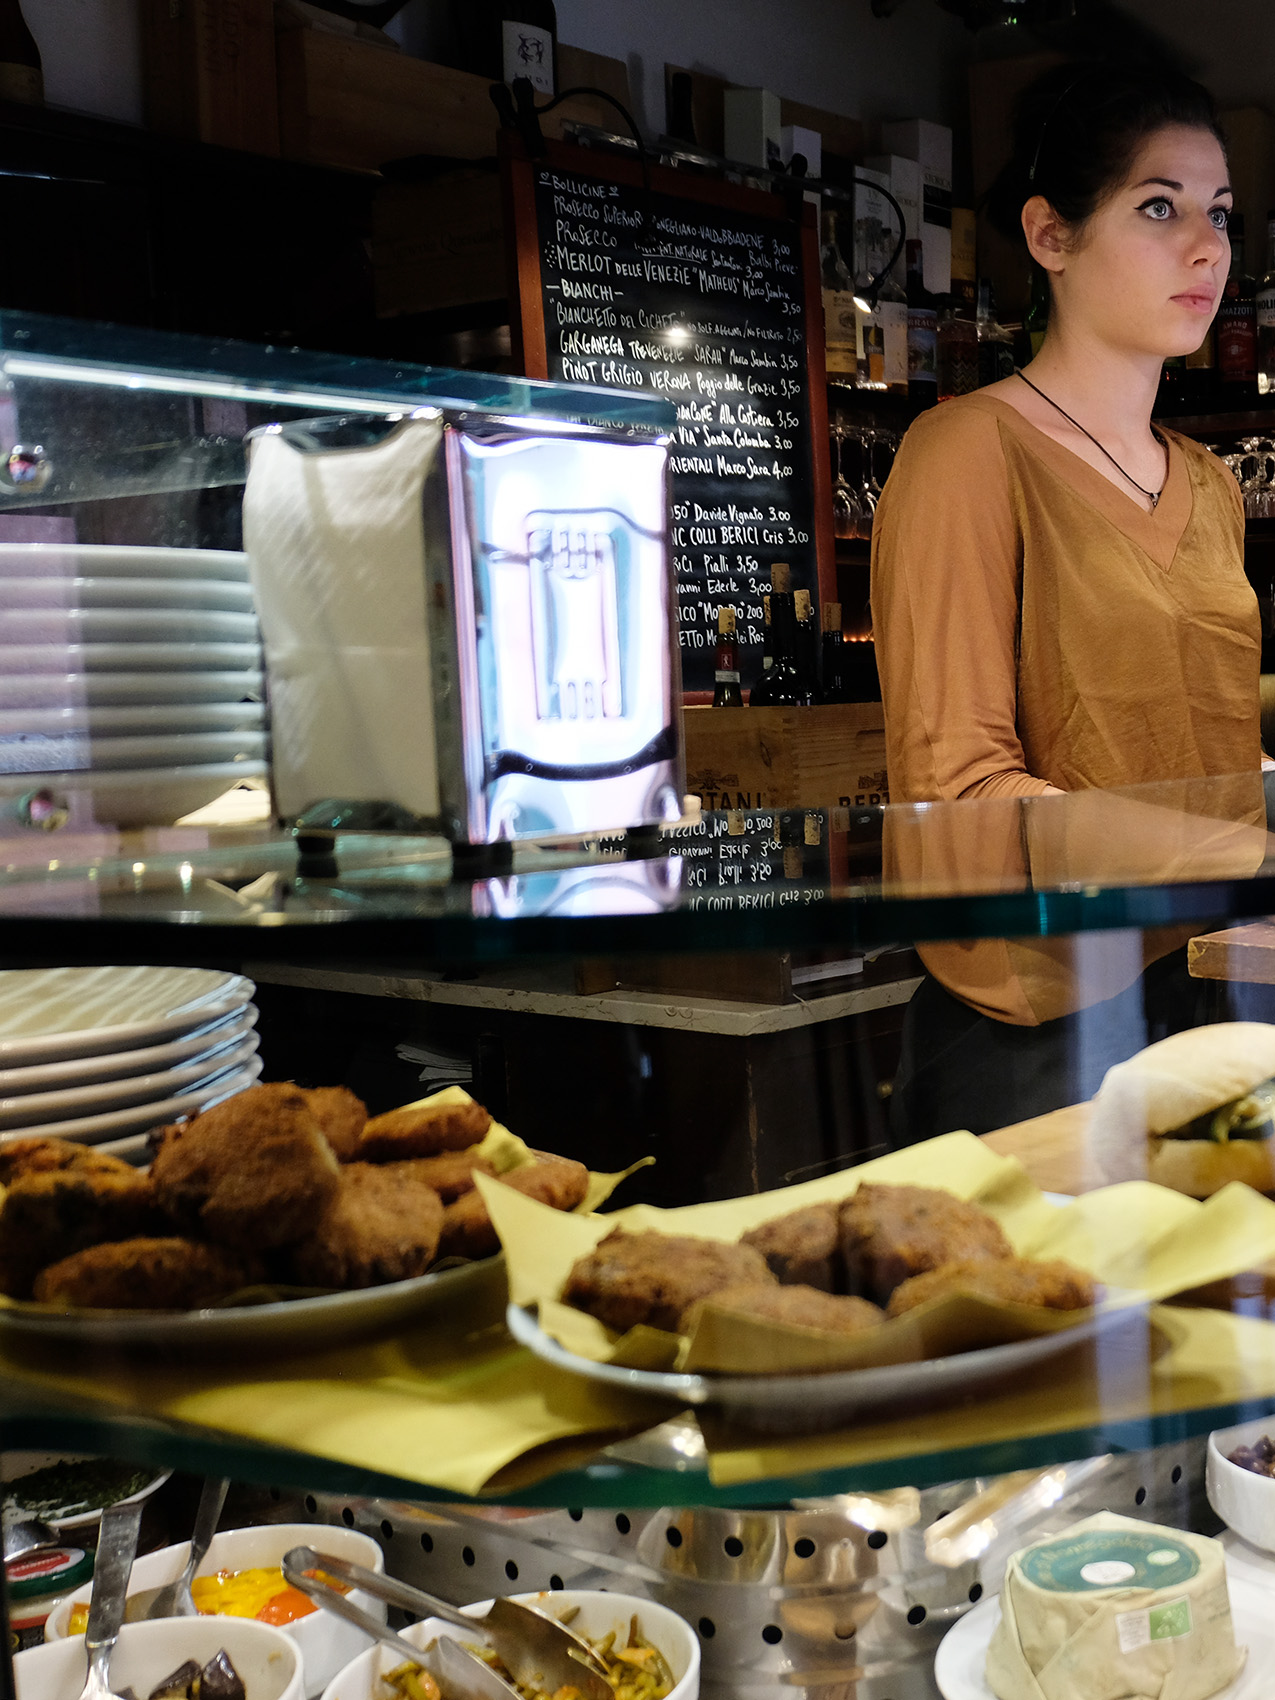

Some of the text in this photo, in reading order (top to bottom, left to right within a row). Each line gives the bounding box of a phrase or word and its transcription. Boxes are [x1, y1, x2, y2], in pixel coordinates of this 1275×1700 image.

[552, 175, 606, 199] BOLLICINE
[553, 195, 600, 220] PROSECCO
[603, 204, 645, 229] SUPERIOR
[556, 219, 617, 248] PROSECCO
[556, 244, 612, 275] MERLOT
[614, 261, 643, 278] DELLE
[643, 259, 692, 286] VENEZIE
[781, 302, 801, 316] 3,50
[560, 329, 624, 357] GARGANEGA
[780, 353, 799, 371] 3,50
[562, 357, 801, 399] PINOT GRIGIO VERONA Poggio delle Grazie 3,50
[719, 403, 736, 425] Alla
[737, 403, 775, 427] Costiera
[777, 410, 799, 429] 3,50
[703, 425, 733, 447] Santa
[733, 427, 771, 449] Colomba
[668, 456, 714, 474] RIENTALI
[716, 454, 746, 477] Marco
[746, 456, 771, 479] Sara
[694, 503, 727, 522] Davide
[728, 504, 764, 525] Vignato
[690, 526, 716, 546] COLLI
[720, 525, 759, 545] BERICI
[763, 529, 784, 545] Cris
[704, 554, 730, 576] Pialli
[736, 554, 758, 574] 3,50
[707, 577, 739, 594] Ederle
[749, 577, 773, 596] 3,00
